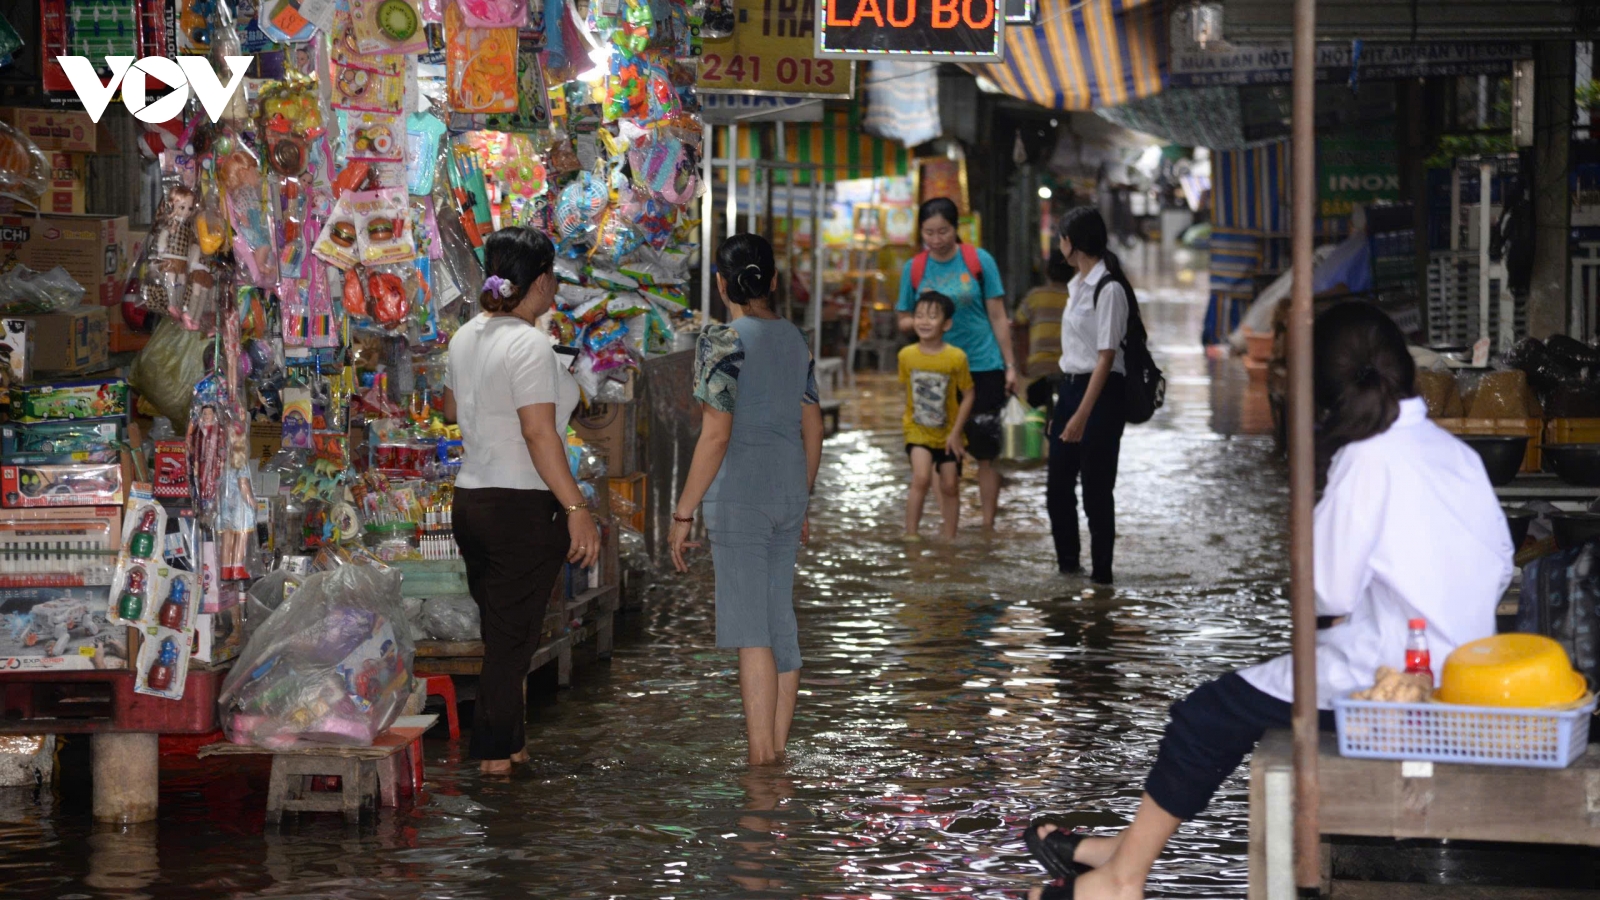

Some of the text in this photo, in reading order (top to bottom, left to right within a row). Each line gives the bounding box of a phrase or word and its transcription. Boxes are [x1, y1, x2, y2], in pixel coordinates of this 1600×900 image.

[702, 53, 835, 87] 241 013
[1329, 174, 1400, 192] INOX
